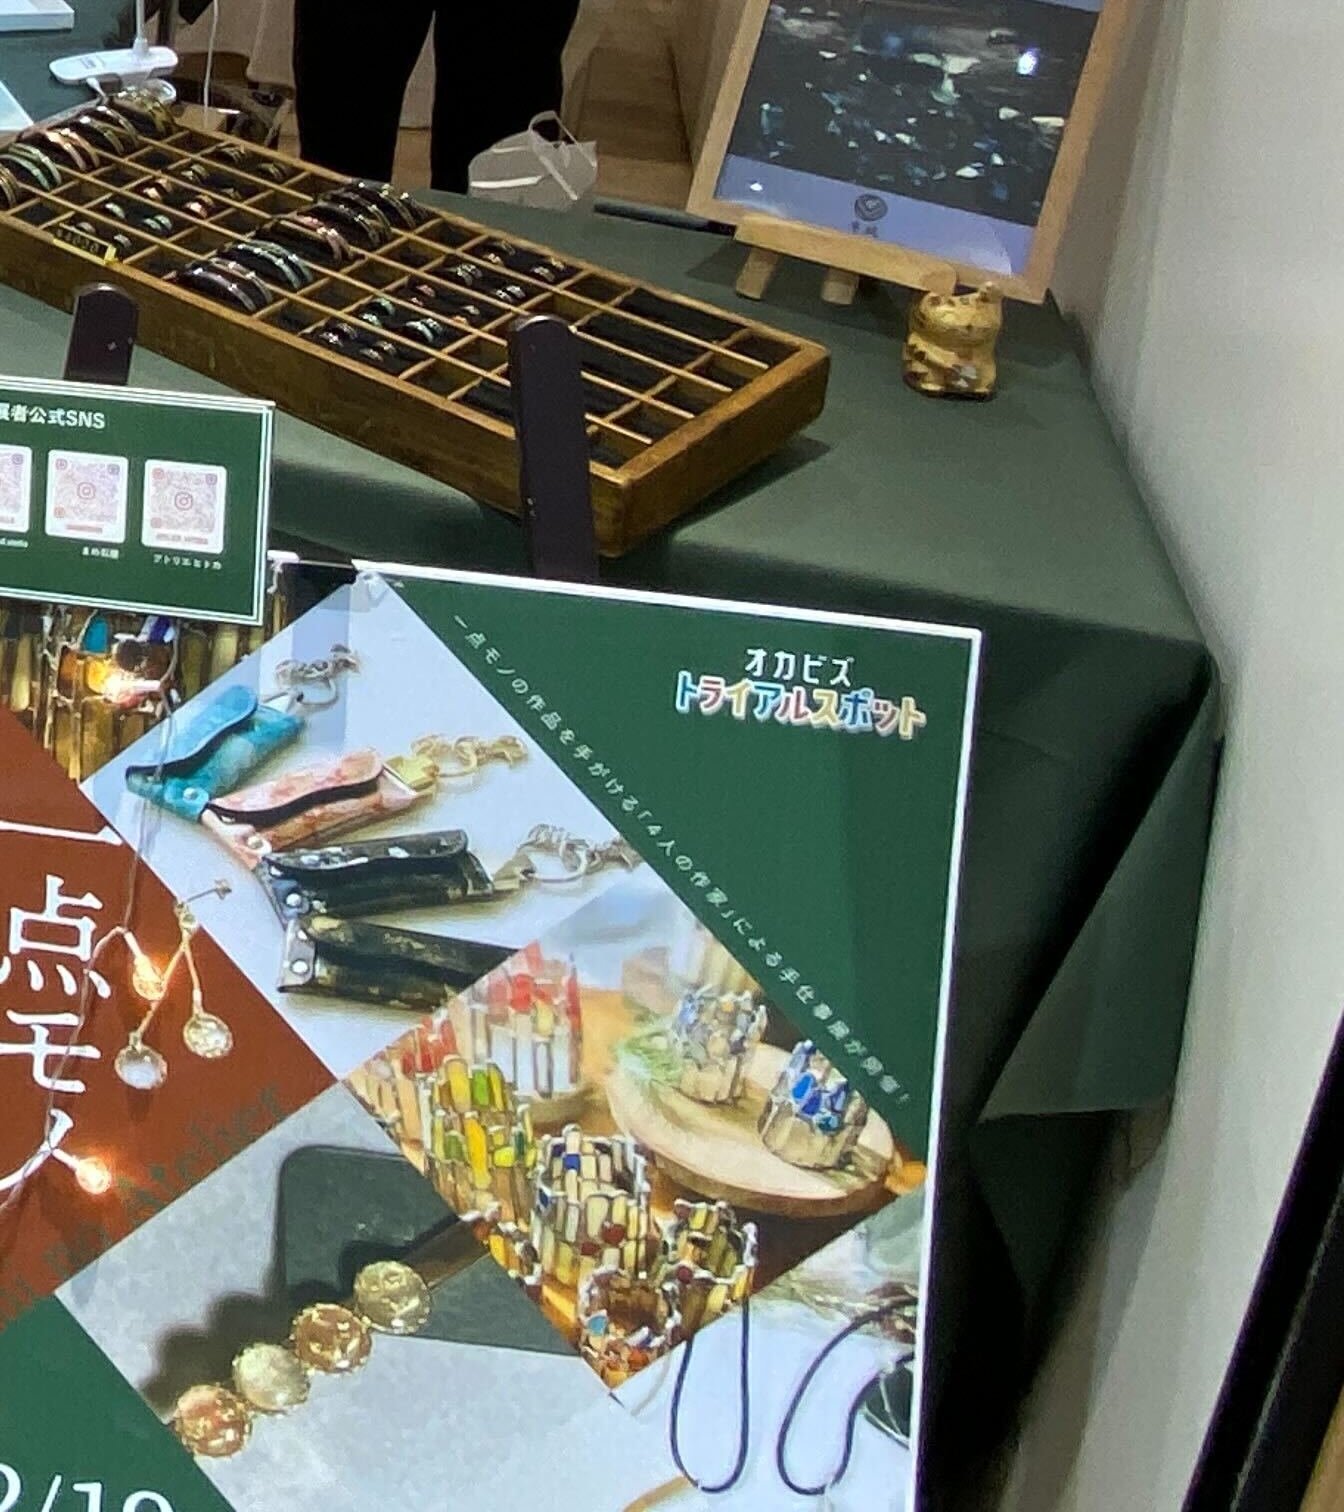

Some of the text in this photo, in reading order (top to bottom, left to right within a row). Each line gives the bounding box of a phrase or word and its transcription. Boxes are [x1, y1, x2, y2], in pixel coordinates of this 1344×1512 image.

[745, 648, 855, 687] オカビズ
[675, 670, 928, 741] トライアルスポット
